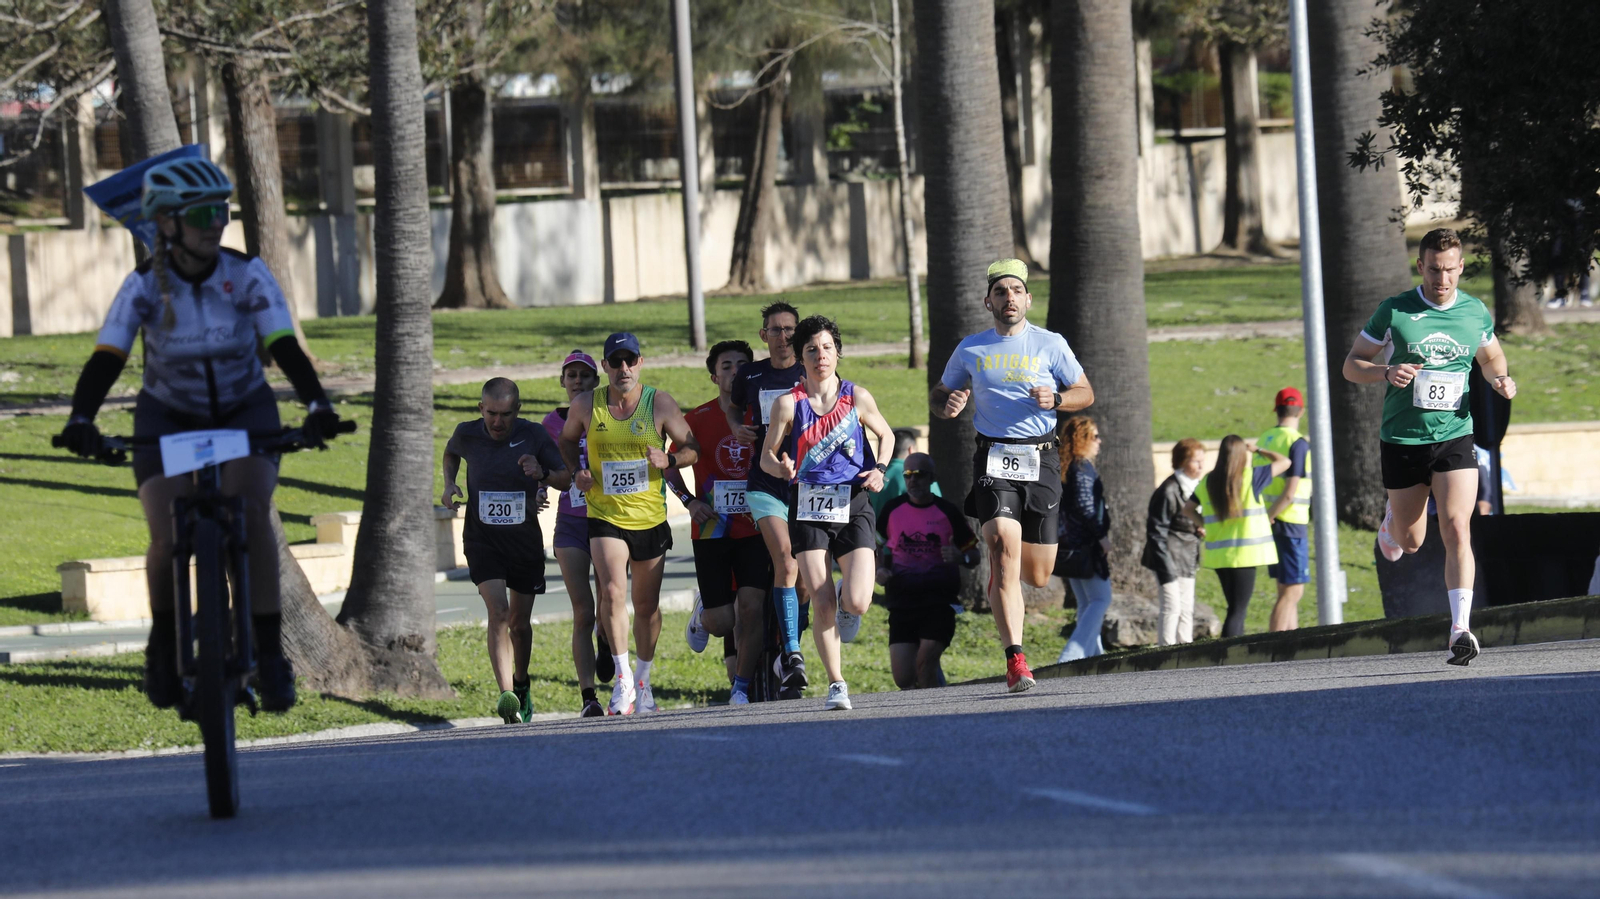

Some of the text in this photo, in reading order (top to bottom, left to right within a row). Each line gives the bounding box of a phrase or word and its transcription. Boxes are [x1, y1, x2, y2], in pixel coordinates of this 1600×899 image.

[1407, 344, 1421, 353] LA
[1424, 344, 1470, 355] TOSCANA
[975, 353, 1041, 373] FATIGAS
[1429, 384, 1446, 400] 83
[815, 432, 848, 463] RUNNERS
[1002, 456, 1019, 471] 96
[611, 472, 636, 487] 255
[723, 492, 745, 506] 175
[808, 496, 833, 512] 174
[488, 503, 511, 517] 230
[782, 595, 795, 637] kalenji
